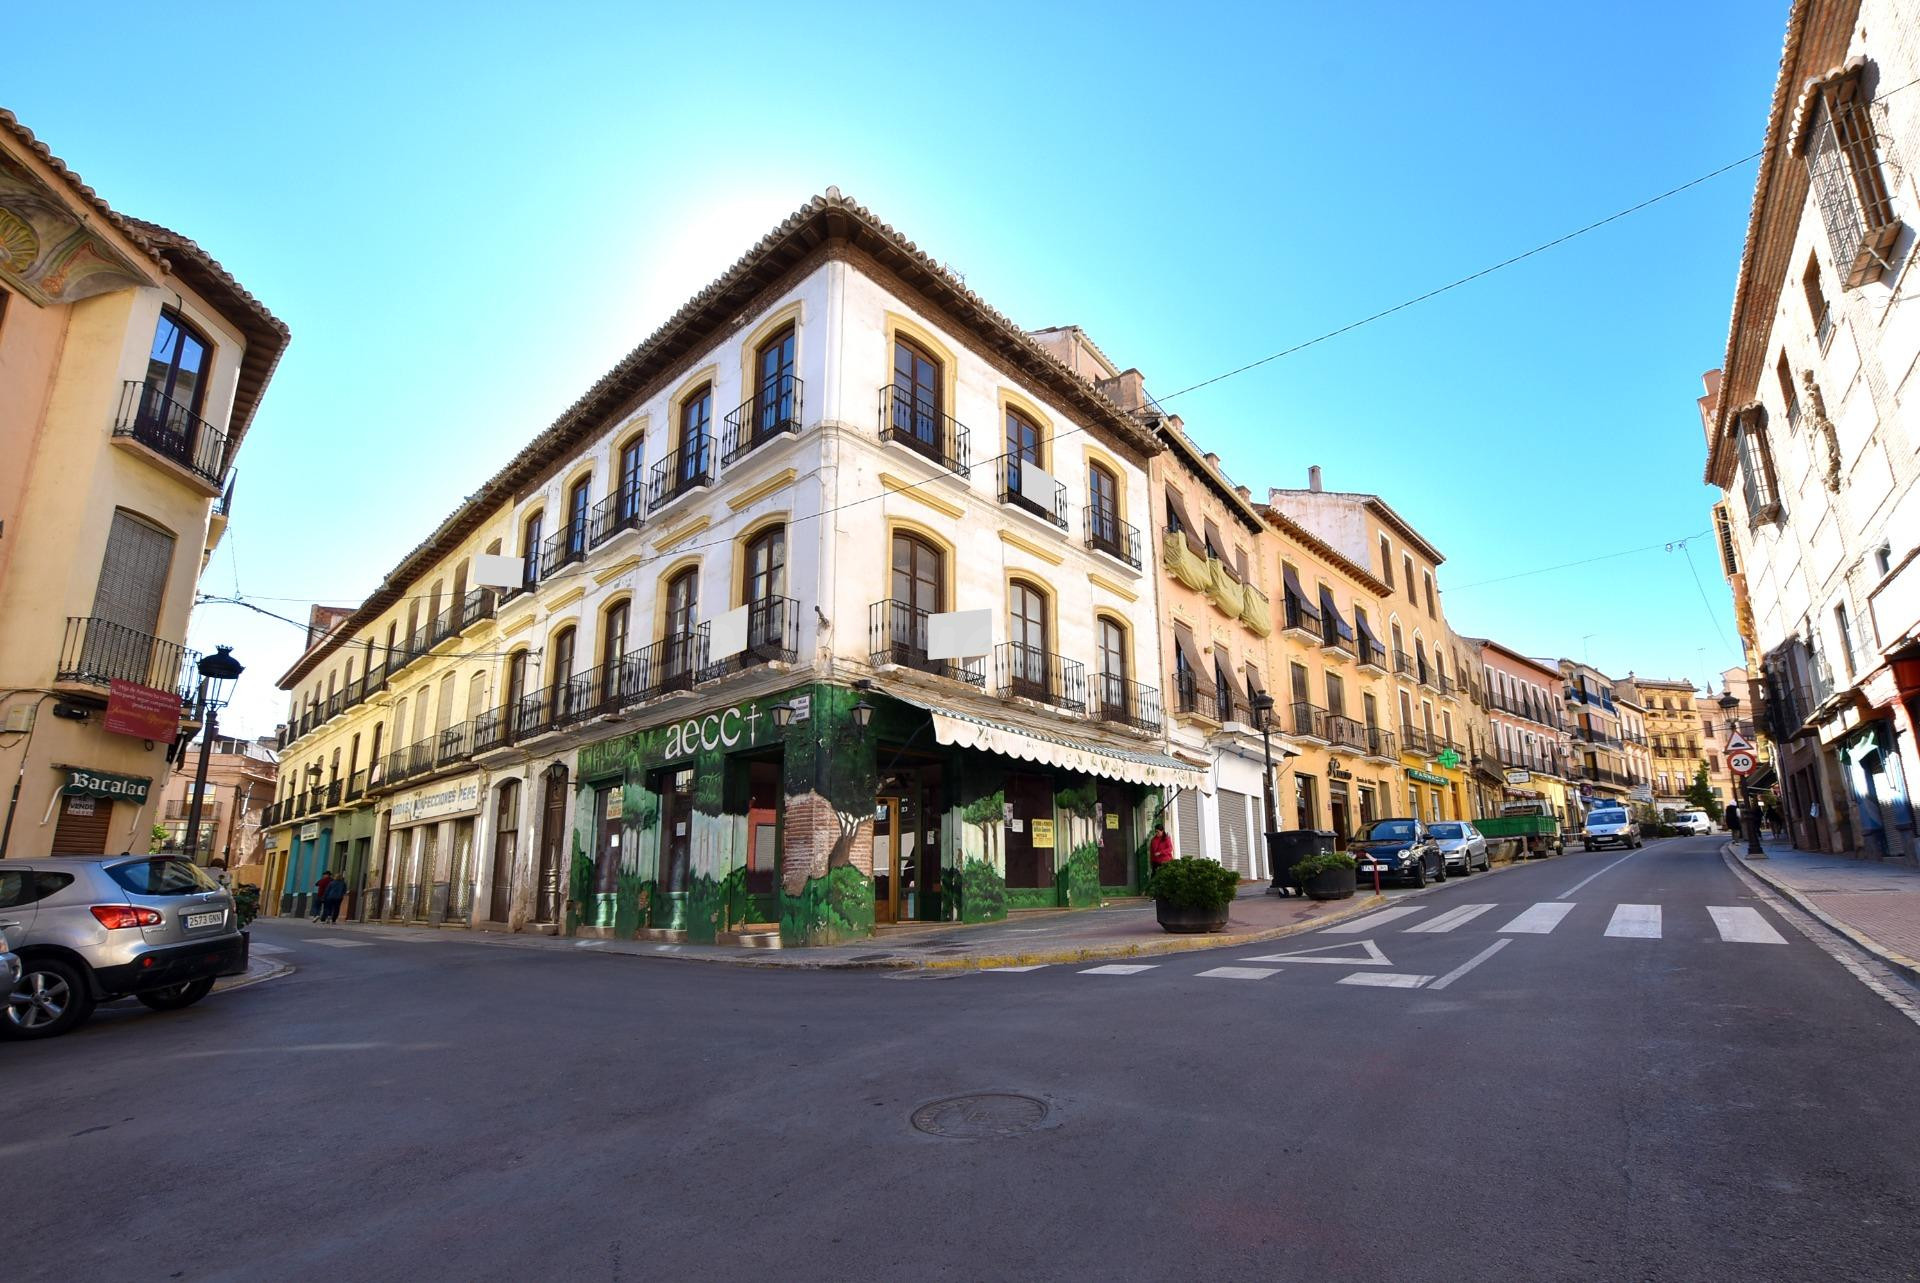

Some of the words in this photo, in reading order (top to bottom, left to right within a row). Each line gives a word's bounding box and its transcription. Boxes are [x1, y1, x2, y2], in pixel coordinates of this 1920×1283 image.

[664, 708, 741, 760] aecc
[1733, 758, 1750, 767] 20
[69, 772, 147, 796] Bacalao
[1413, 770, 1446, 784] FARMACIA
[189, 915, 208, 927] 2573
